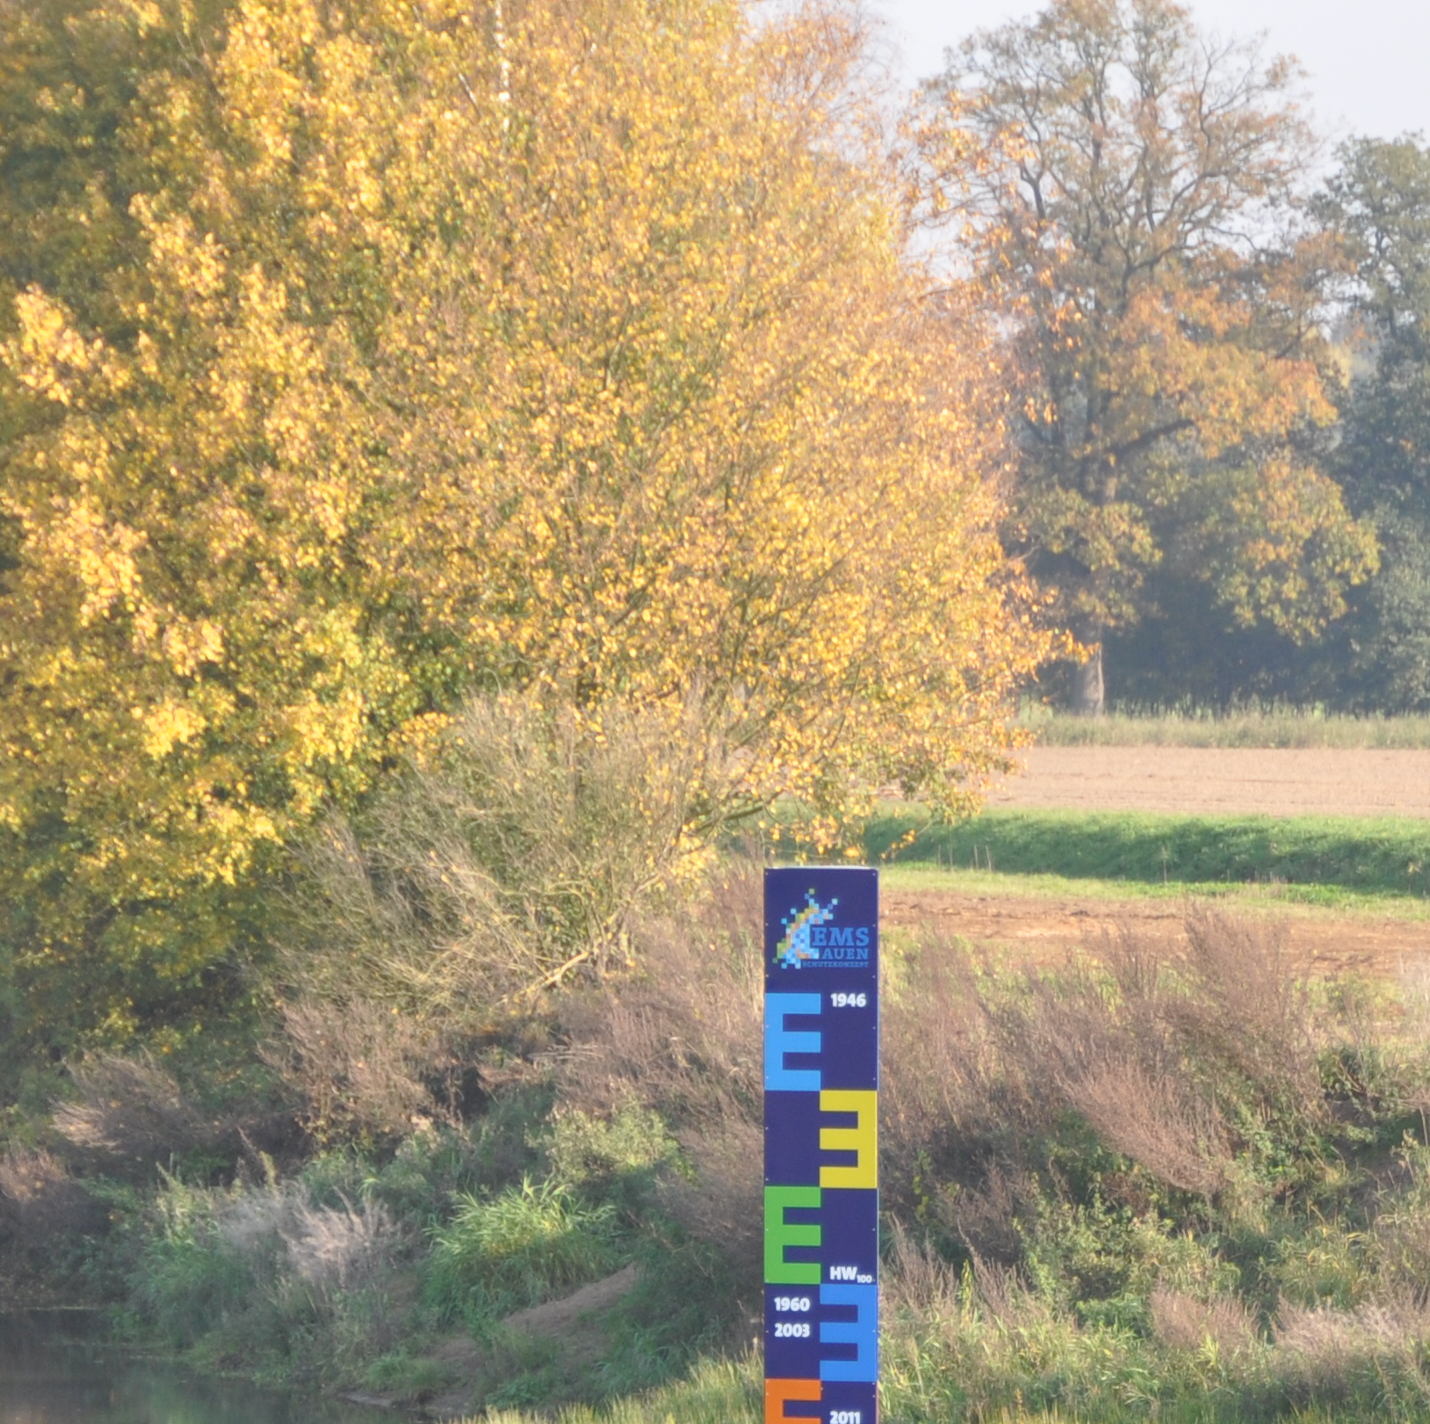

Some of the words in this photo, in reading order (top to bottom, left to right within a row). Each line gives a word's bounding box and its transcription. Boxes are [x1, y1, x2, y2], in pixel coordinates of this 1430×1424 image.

[811, 926, 870, 947] EMS
[821, 947, 869, 960] AUEN
[830, 992, 867, 1008] 1946
[774, 1296, 811, 1312] 1960
[774, 1322, 811, 1338] 2003
